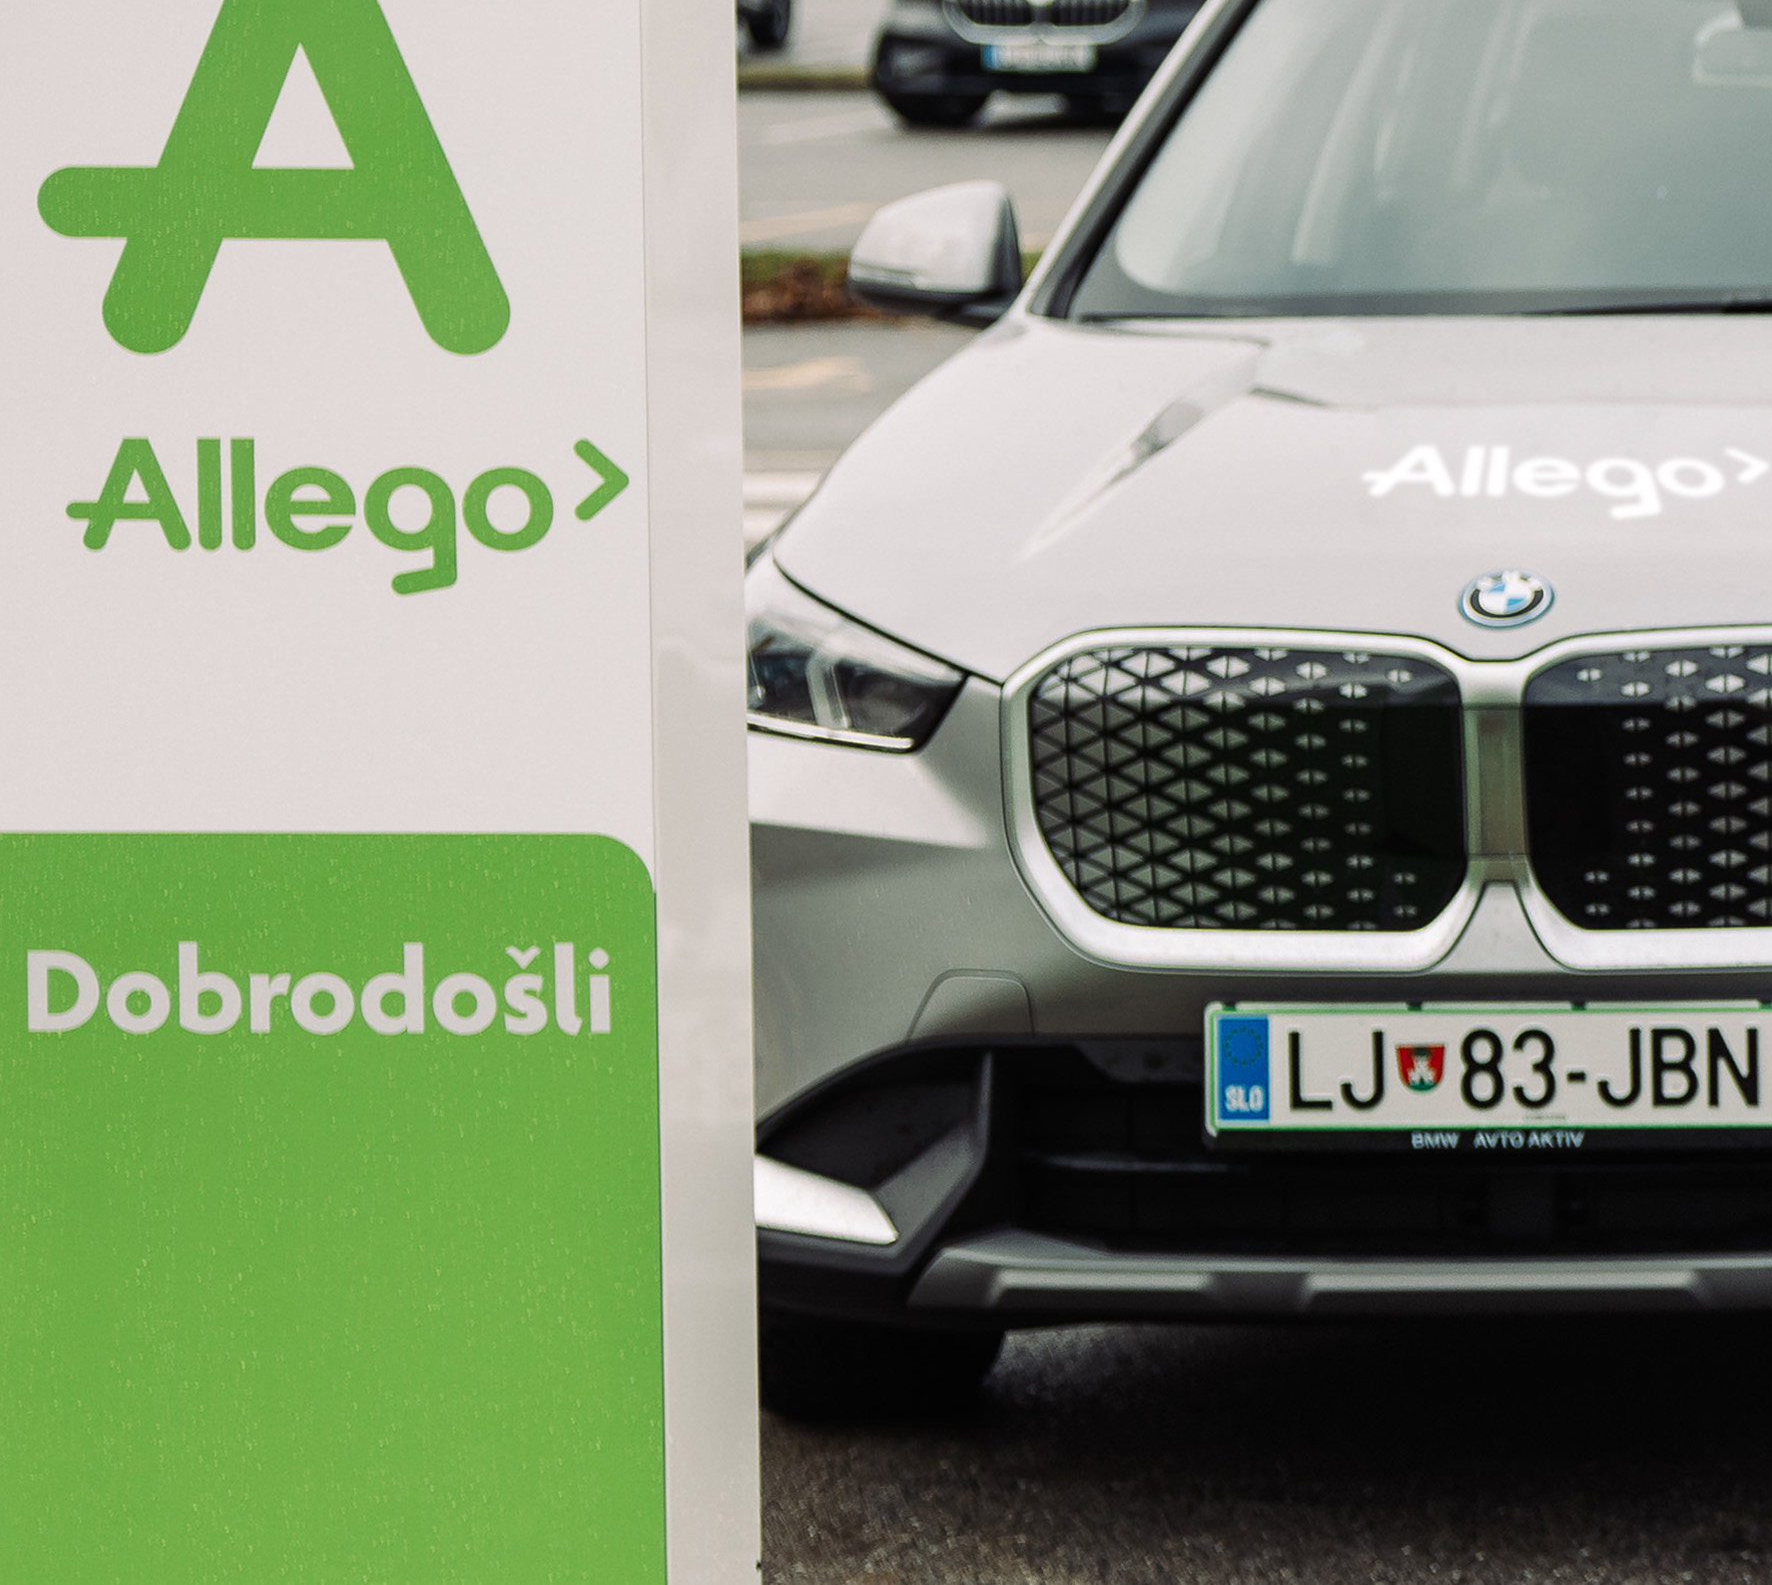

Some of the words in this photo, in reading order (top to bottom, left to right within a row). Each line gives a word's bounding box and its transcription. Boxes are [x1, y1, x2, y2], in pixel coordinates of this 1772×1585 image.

[66, 437, 555, 596] Allego
[1361, 445, 1725, 520] Allego
[26, 940, 612, 1037] Dobrodošli
[1224, 1085, 1265, 1113] SLO
[1288, 1029, 1386, 1112] LJ
[1459, 1027, 1760, 1110] 83-JBN
[1411, 1130, 1459, 1150] BMW
[1473, 1130, 1524, 1150] AVTO
[1528, 1130, 1586, 1150] AKTIV
